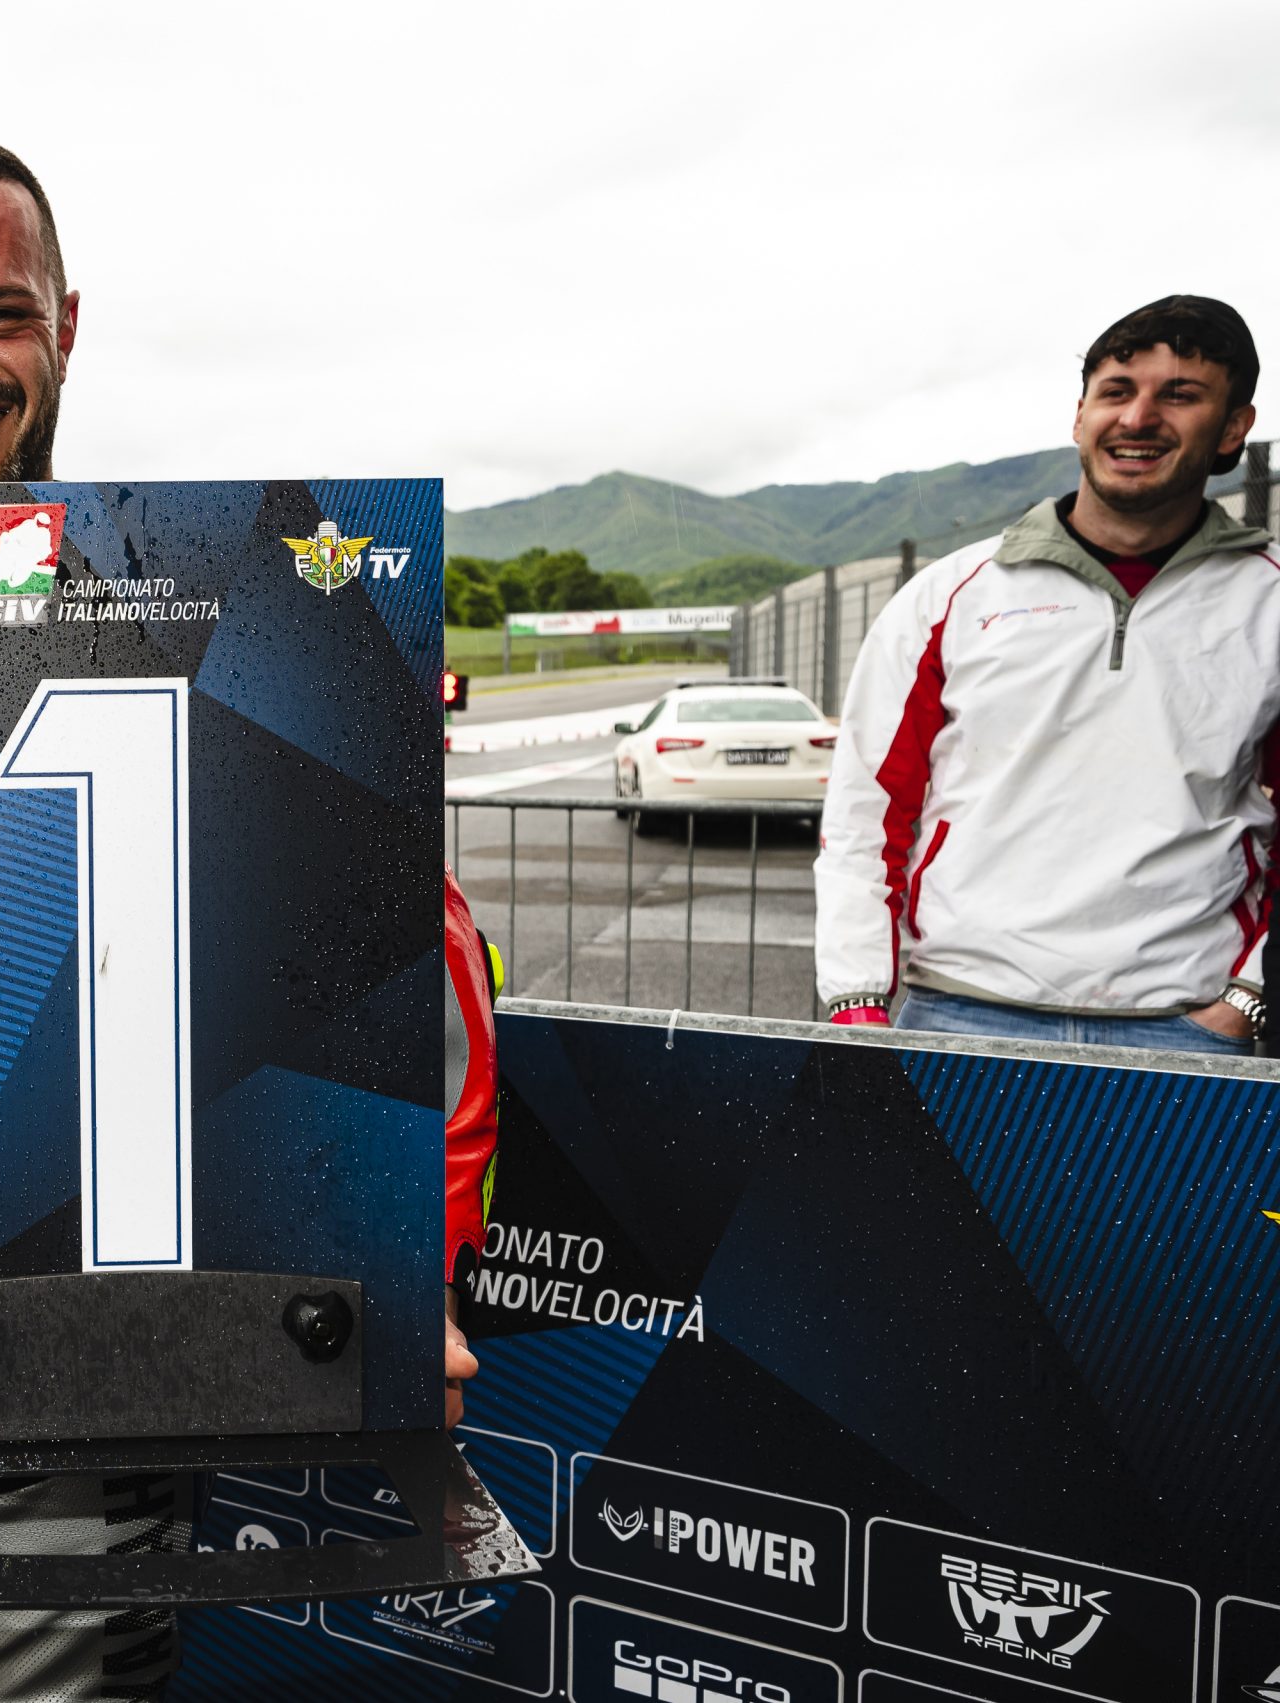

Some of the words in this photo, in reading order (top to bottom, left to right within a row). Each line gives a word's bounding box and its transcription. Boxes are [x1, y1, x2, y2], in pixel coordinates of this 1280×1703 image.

[368, 554, 411, 579] TV
[369, 546, 412, 555] Federmoto
[62, 577, 175, 599] CAMPIONATO
[57, 597, 221, 622] ITALIANOVELOCITÀ
[727, 751, 764, 764] SAFETY
[767, 750, 790, 764] CAR
[670, 1516, 679, 1548] VIRUS
[668, 1509, 816, 1588] POWER
[940, 1553, 1113, 1616] BERIK
[372, 1609, 430, 1630] motorcycle
[467, 1636, 496, 1650] parts
[963, 1630, 1072, 1670] RACING
[614, 1640, 791, 1703] GoPro
